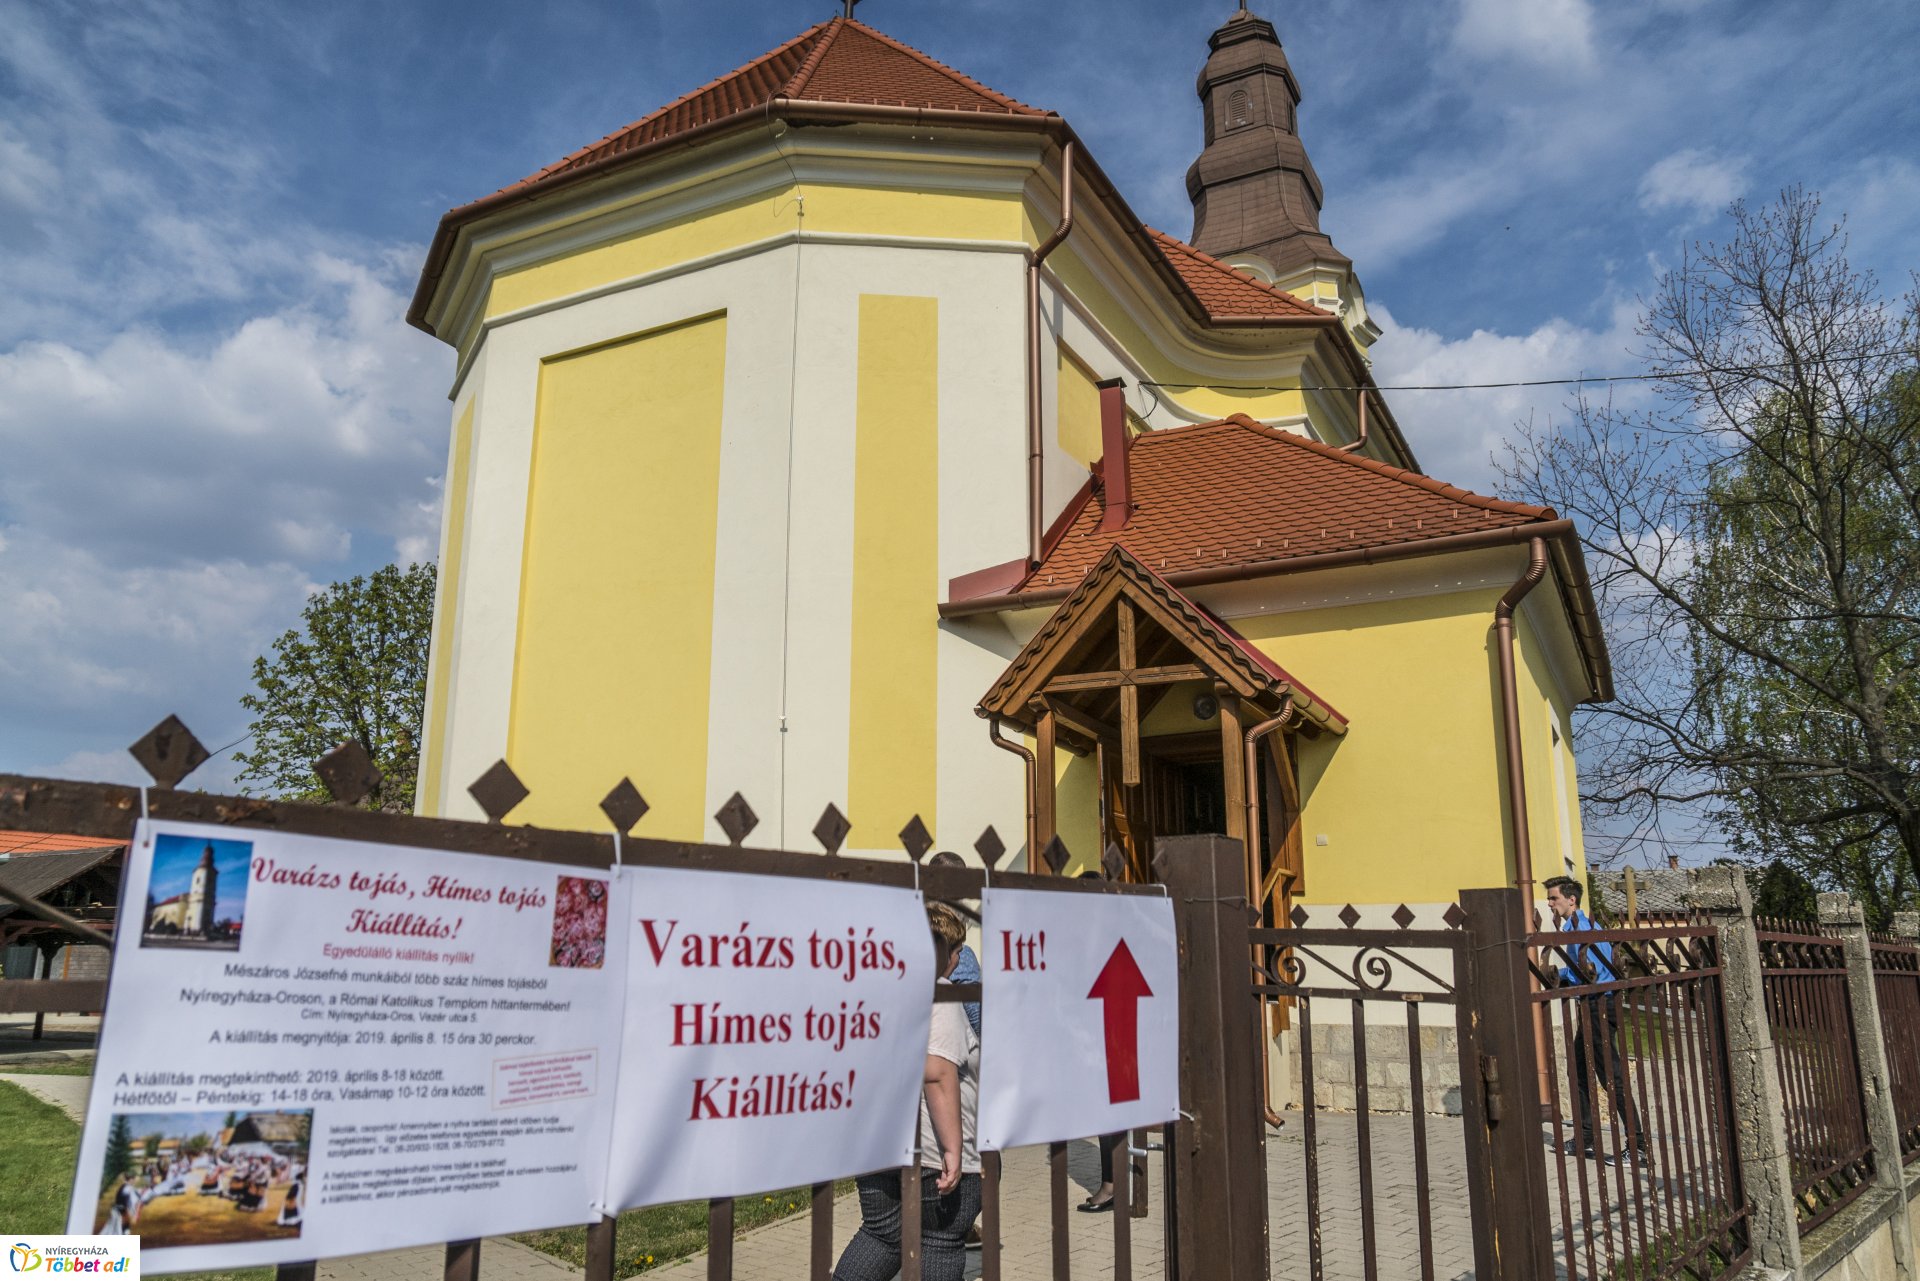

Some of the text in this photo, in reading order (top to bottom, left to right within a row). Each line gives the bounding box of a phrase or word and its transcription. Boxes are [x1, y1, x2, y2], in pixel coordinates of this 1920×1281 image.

[252, 857, 547, 912] Varázs tojás, Hímes tojás
[345, 908, 463, 940] Kiállítás!
[323, 943, 392, 960] Egyedülálló
[395, 947, 439, 962] kiállítás
[640, 919, 906, 982] Varázs tojás,
[1001, 930, 1047, 972] Itt!
[224, 964, 547, 991] Mészáros Józsefné munkáiból több száz hímes tojásból
[301, 1008, 323, 1020] Cím:
[419, 1011, 446, 1022] Vezér
[449, 1012, 468, 1022] utca
[328, 995, 337, 1005] a
[340, 991, 377, 1006] Római
[381, 994, 433, 1008] Katolikus
[438, 996, 488, 1011] Templom
[491, 998, 571, 1012] hittantermében!
[209, 1030, 537, 1047] A kiállítás megnyitója: 2019. április 8. 15 óra 30 perckor.
[670, 1002, 882, 1052] Hímes tojás
[116, 1069, 444, 1088] A kiállítás megtekinthető: 2019. április 8-18 között.
[113, 1091, 177, 1106] Hétfőtől
[196, 1089, 265, 1106] Péntekig:
[271, 1089, 307, 1102] 14-18
[311, 1089, 334, 1102] óra,
[339, 1087, 394, 1100] Vasárnap
[398, 1086, 428, 1098] 10-12
[430, 1087, 448, 1098] óra
[451, 1085, 486, 1097] között.
[688, 1070, 856, 1122] Kiállítás!
